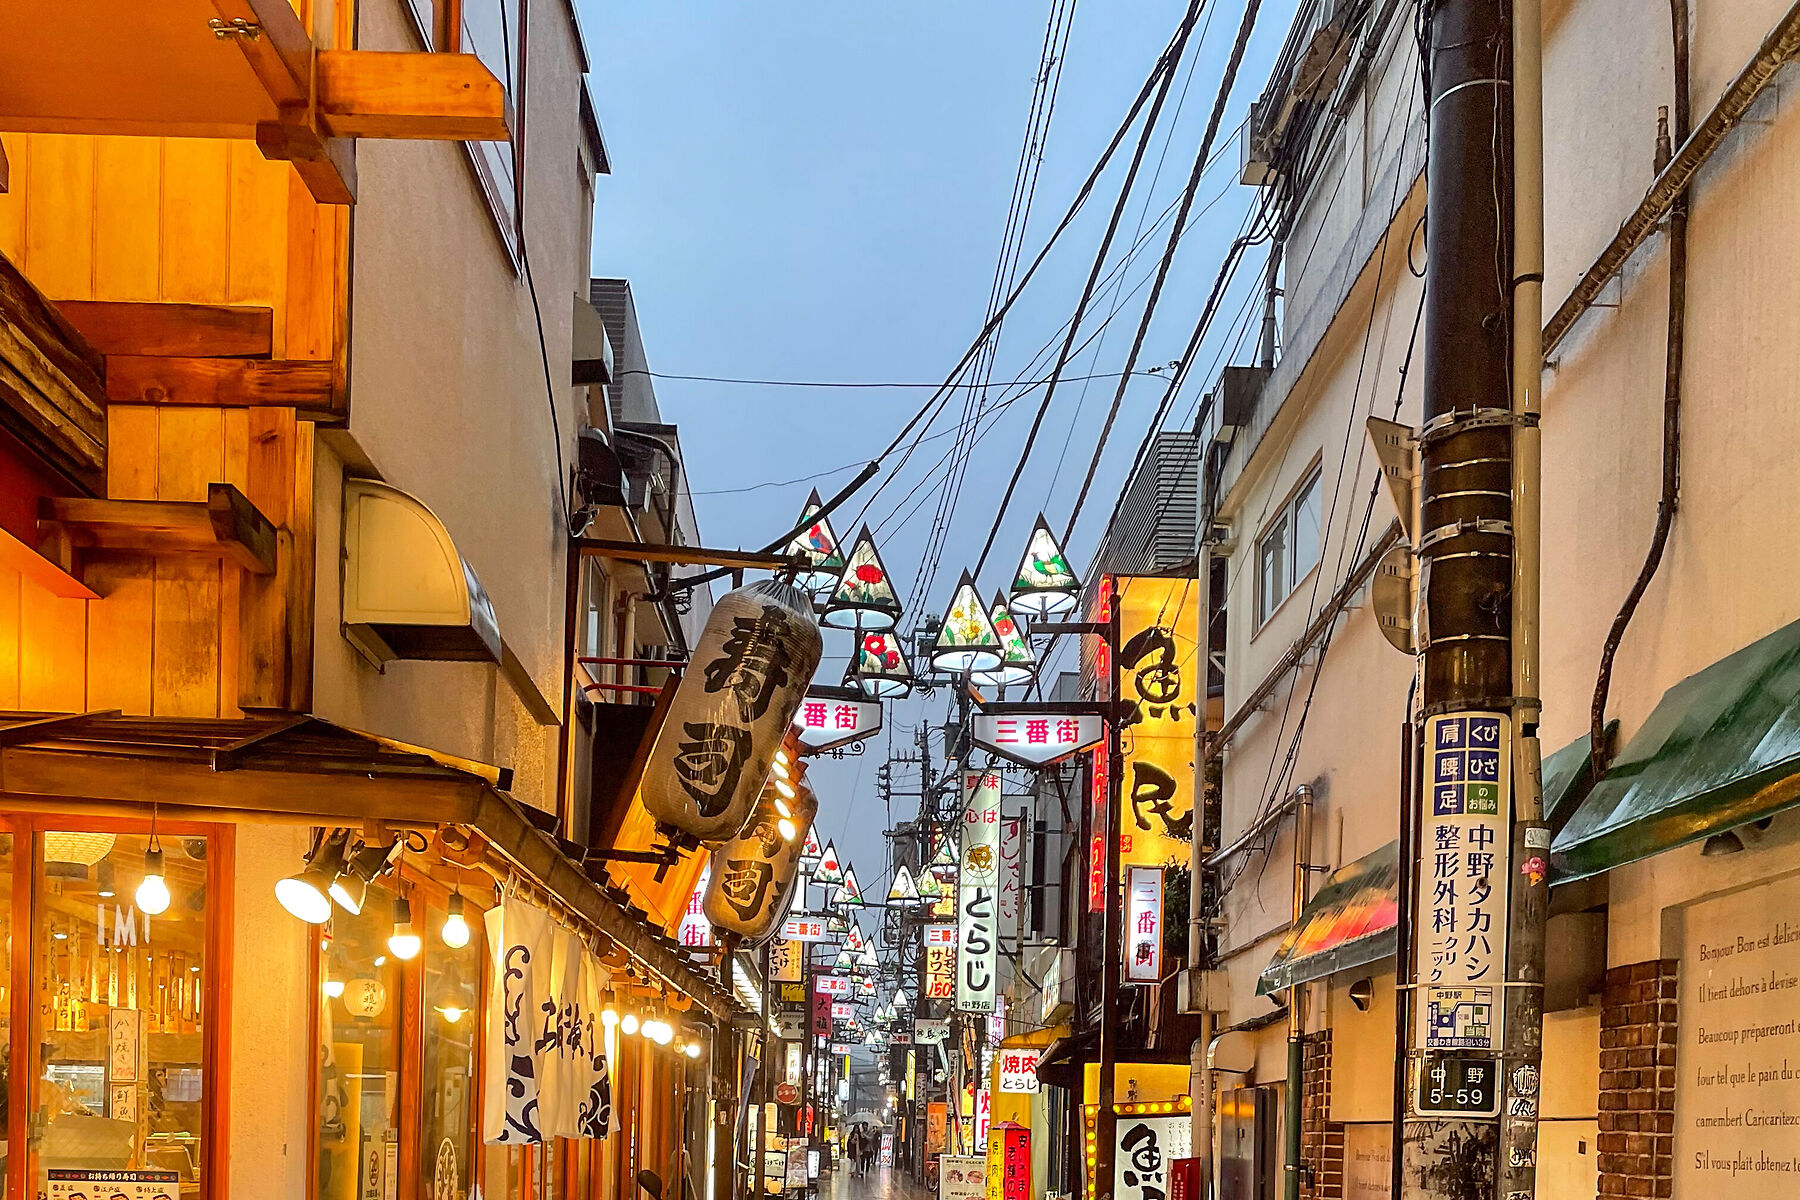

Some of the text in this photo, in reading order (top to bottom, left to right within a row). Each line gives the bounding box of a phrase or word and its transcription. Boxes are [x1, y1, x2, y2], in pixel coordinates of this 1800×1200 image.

[673, 605, 792, 818] 寿司
[995, 719, 1079, 744] 三番街
[1120, 626, 1196, 832] 魚民
[1441, 724, 1460, 744] 肩
[1471, 725, 1498, 742] くび
[1440, 757, 1459, 777] 腰
[1470, 758, 1497, 775] ひざ
[1440, 790, 1458, 810] 足
[1479, 787, 1489, 797] の
[1468, 799, 1496, 811] お悩み
[1432, 824, 1461, 933] 整形外科
[1464, 824, 1495, 981] 中野タカハシ
[786, 922, 821, 936] 三番街
[965, 887, 993, 992] とらじ
[1700, 943, 1735, 963] Bonjour
[1737, 935, 1755, 954] Bon
[1757, 931, 1770, 949] est
[1437, 991, 1463, 1000] 中野駅
[1707, 985, 1729, 1002] tient
[1730, 976, 1760, 998] dehors
[1761, 977, 1767, 993] à
[962, 1001, 991, 1009] 中野店
[1698, 1027, 1740, 1045] Beaucoup
[1002, 1055, 1038, 1074] 焼肉
[1697, 1065, 1715, 1087] four
[1716, 1063, 1728, 1084] tel
[1730, 1071, 1746, 1089] que
[1747, 1062, 1756, 1083] le
[1758, 1066, 1779, 1087] pain
[1781, 1058, 1793, 1081] du
[1003, 1079, 1037, 1090] とらじ
[1431, 1067, 1484, 1084] 中野
[1430, 1089, 1483, 1104] 5-59
[1695, 1106, 1743, 1128] camembert
[1711, 1159, 1731, 1171] vous
[1755, 1149, 1791, 1173] obtenez
